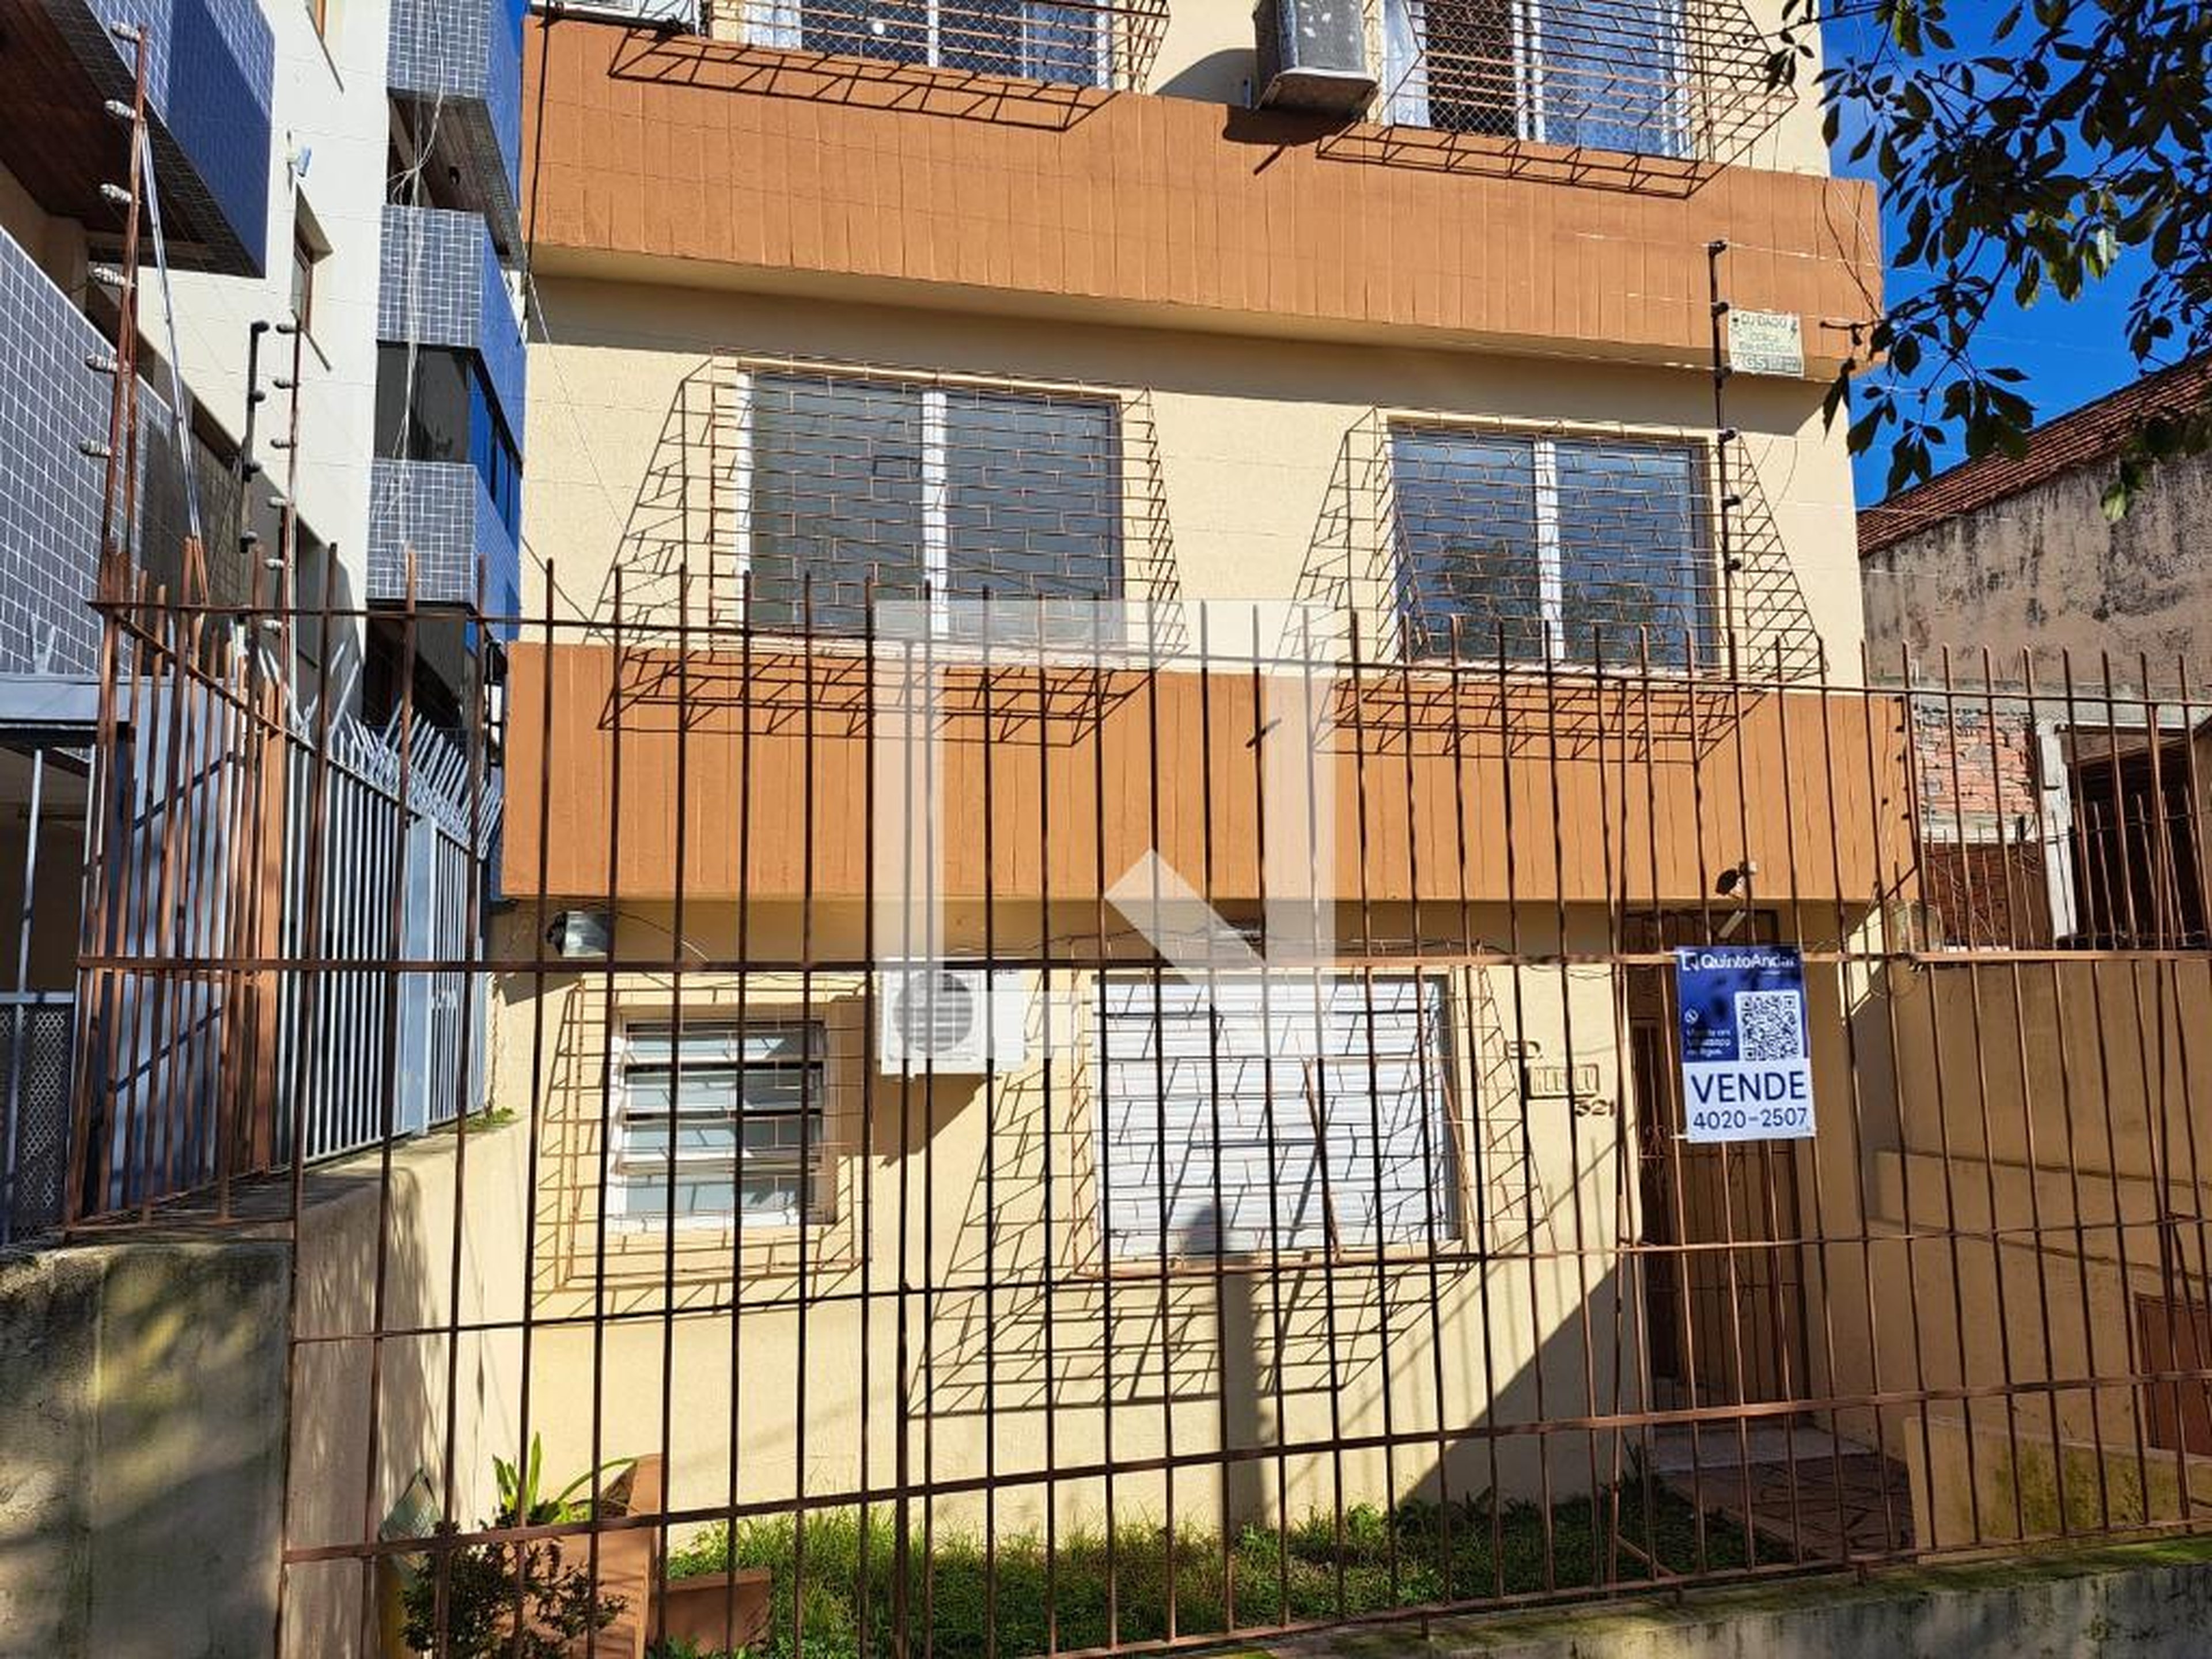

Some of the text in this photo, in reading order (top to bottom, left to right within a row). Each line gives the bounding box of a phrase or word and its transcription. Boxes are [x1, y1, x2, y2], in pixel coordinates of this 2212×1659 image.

[1700, 953, 1795, 969] QuintoAndar
[1691, 1071, 1807, 1103] VENDE
[1693, 1107, 1808, 1130] 4020-2507
